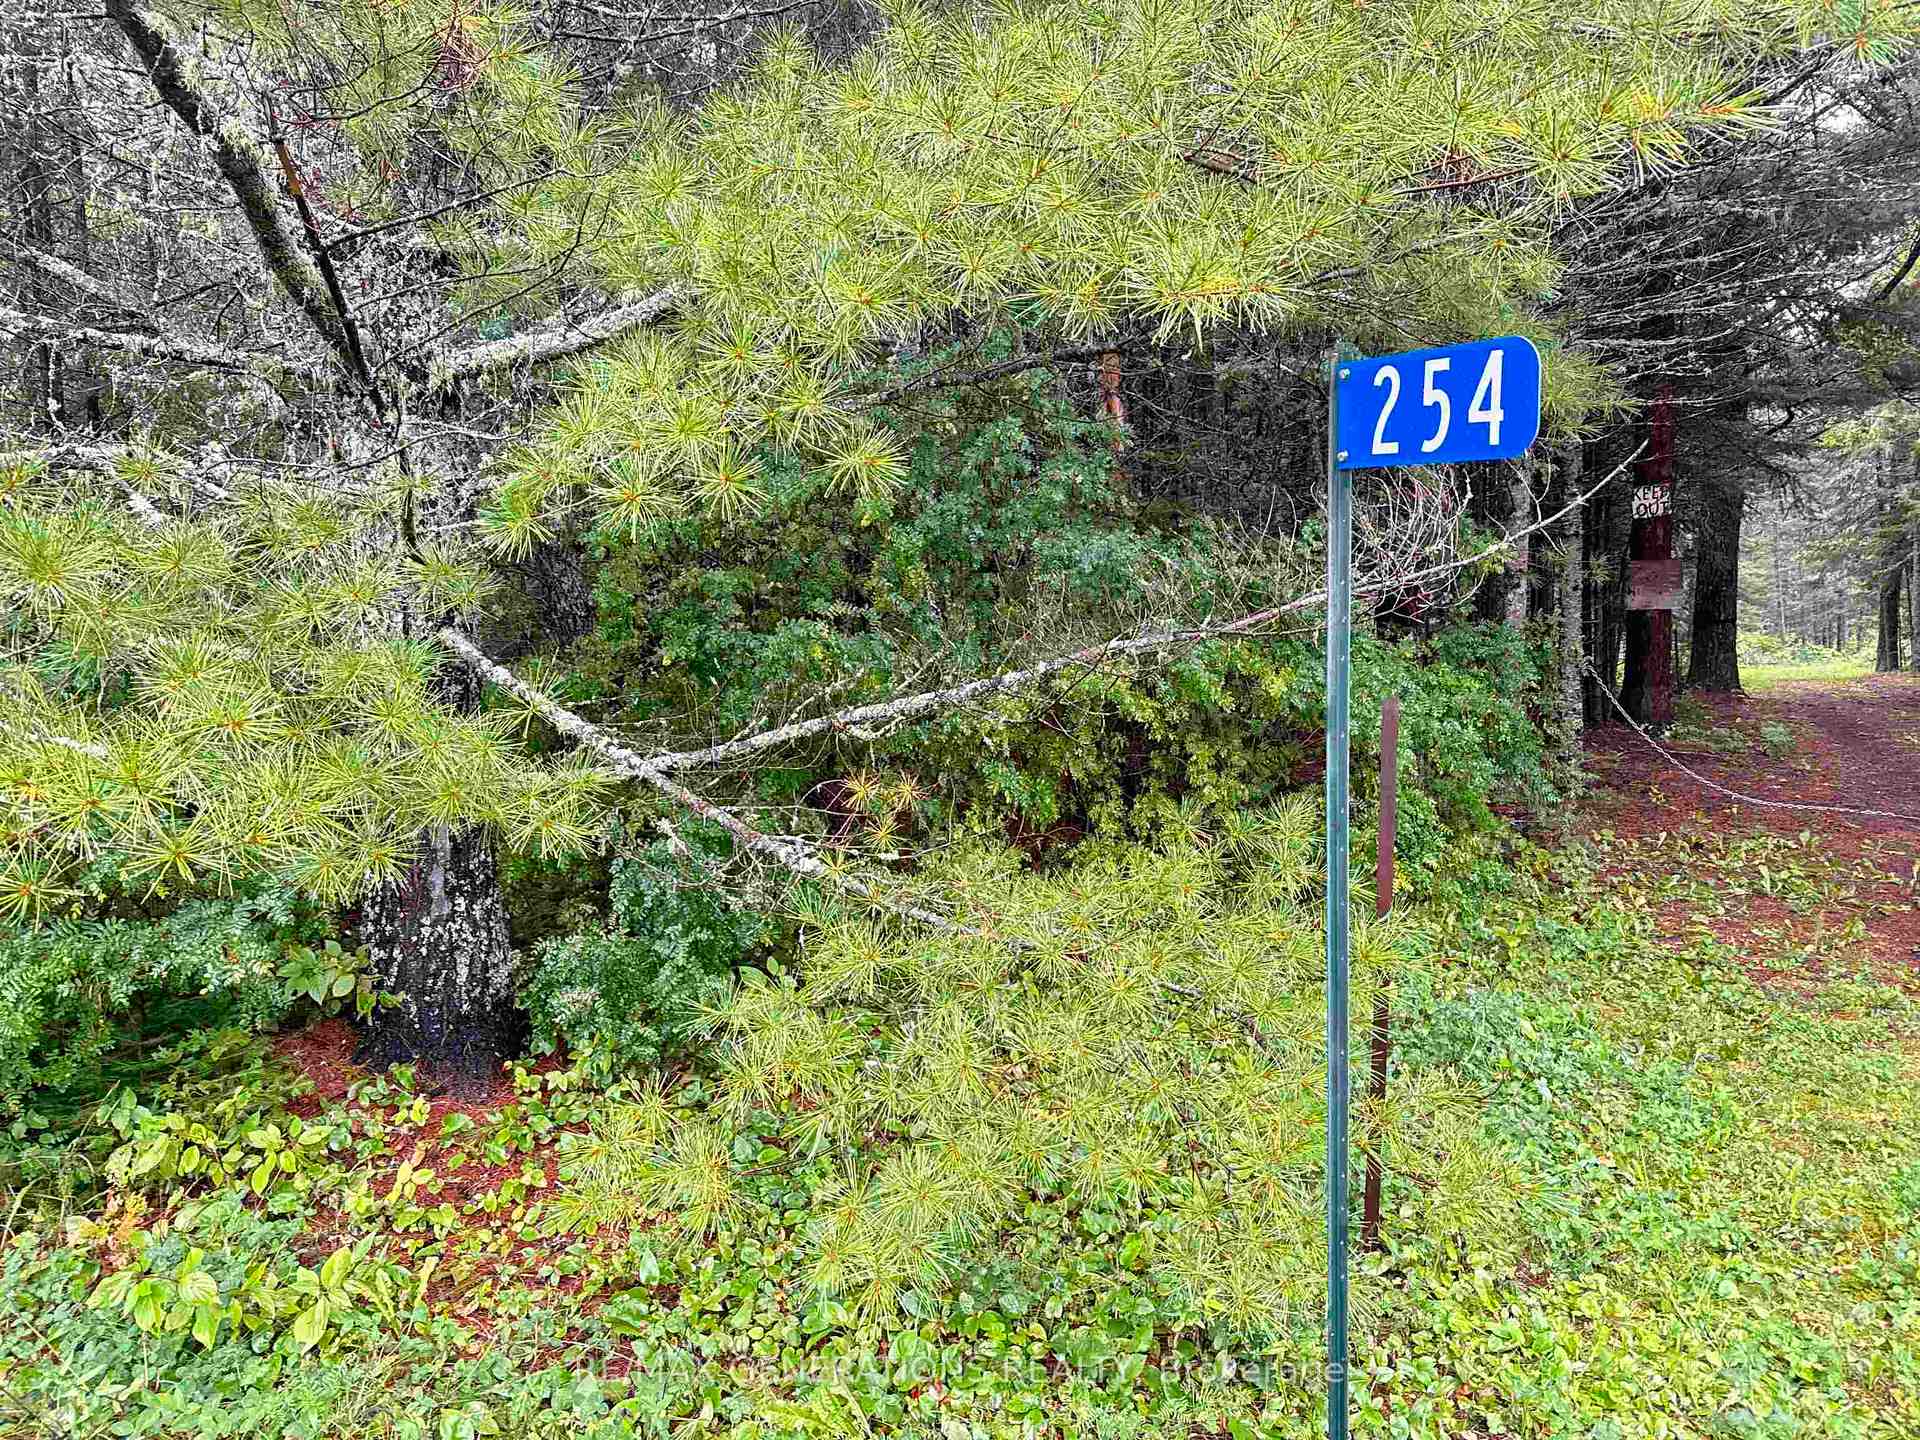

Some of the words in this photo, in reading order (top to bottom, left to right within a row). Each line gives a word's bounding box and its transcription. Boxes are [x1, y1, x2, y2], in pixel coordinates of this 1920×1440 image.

[1371, 349, 1504, 455] 254
[1632, 485, 1669, 500] KEEP
[1636, 500, 1669, 516] OUT
